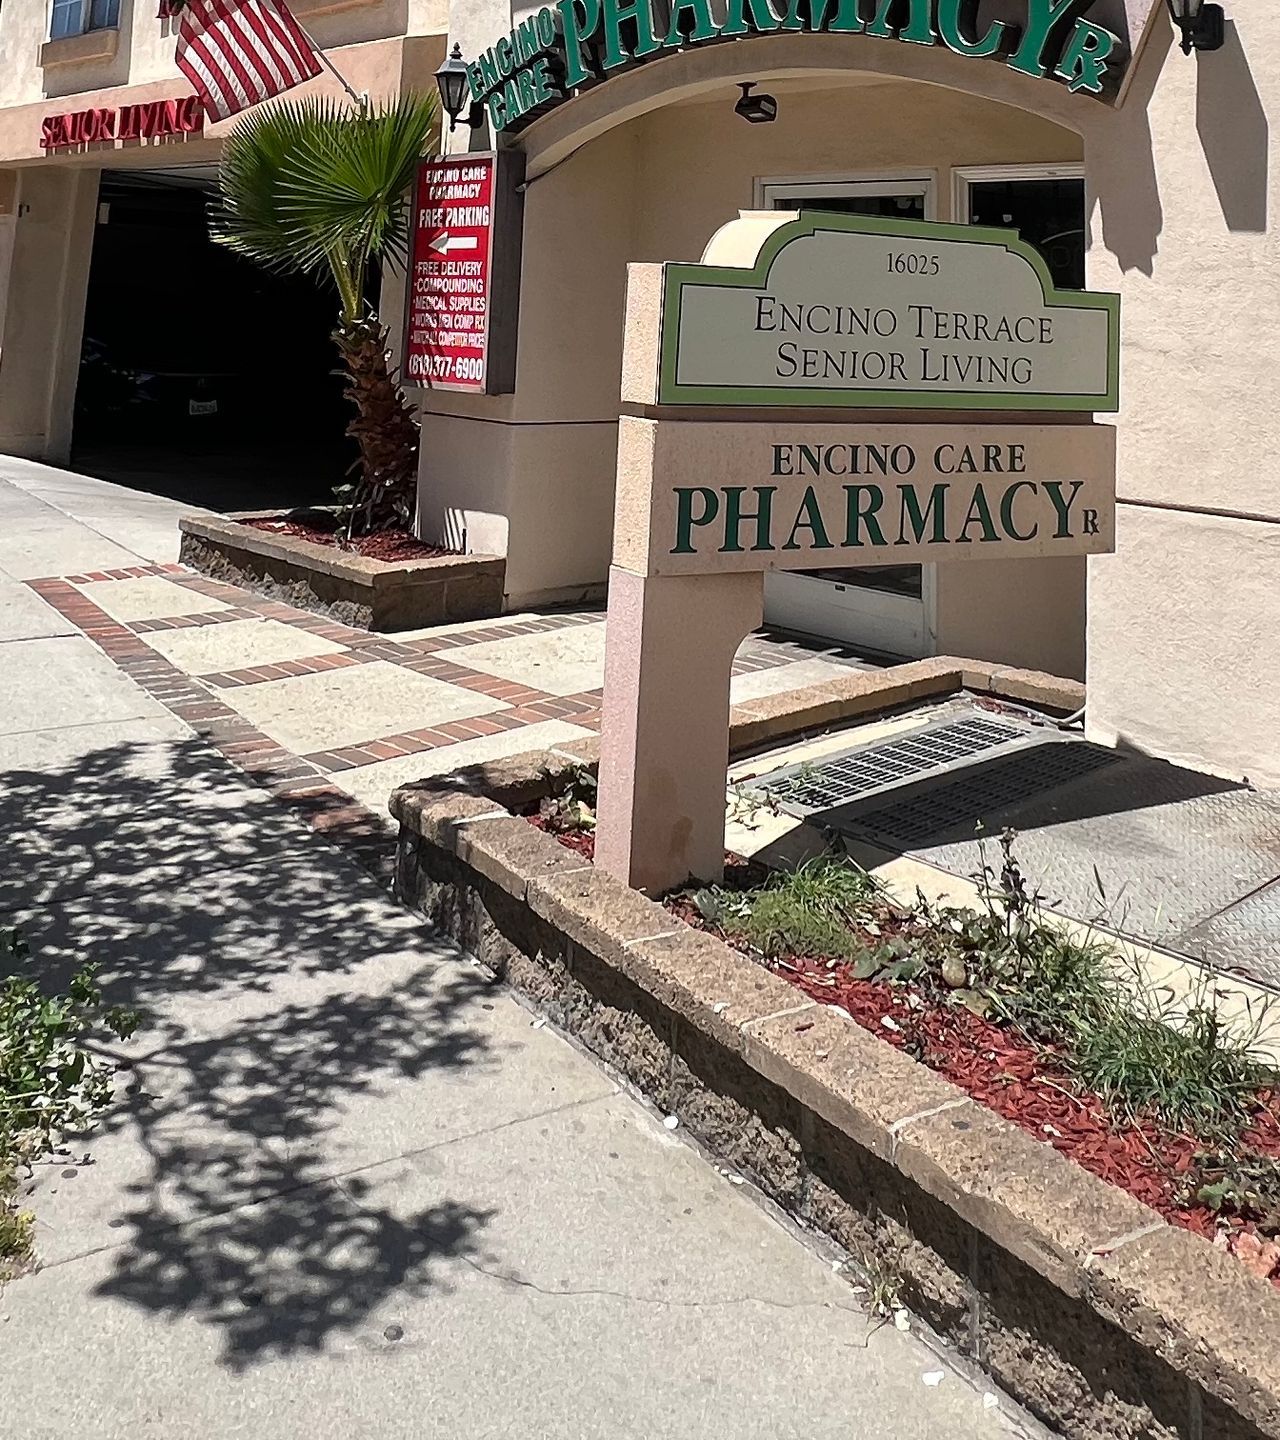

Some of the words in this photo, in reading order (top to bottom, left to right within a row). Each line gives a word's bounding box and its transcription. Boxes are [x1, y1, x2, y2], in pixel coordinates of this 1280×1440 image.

[466, 7, 556, 102] ENCINO
[489, 58, 554, 132] CARE
[40, 108, 116, 148] SENIOR
[118, 95, 204, 140] LIVING
[426, 168, 460, 184] ENCINO
[461, 166, 487, 181] CARE
[429, 183, 481, 200] PHARMACY
[419, 208, 444, 228] FREE
[445, 206, 489, 227] PARKING
[418, 261, 439, 275] FREE
[441, 261, 483, 275] DELIVERY
[886, 253, 941, 276] 16025
[417, 278, 483, 293] COMPOUNDING
[449, 296, 485, 311] SUPPLIES
[771, 444, 916, 476] ENCINO
[934, 444, 1027, 473] CARE
[670, 480, 1084, 554] PHARMACY
